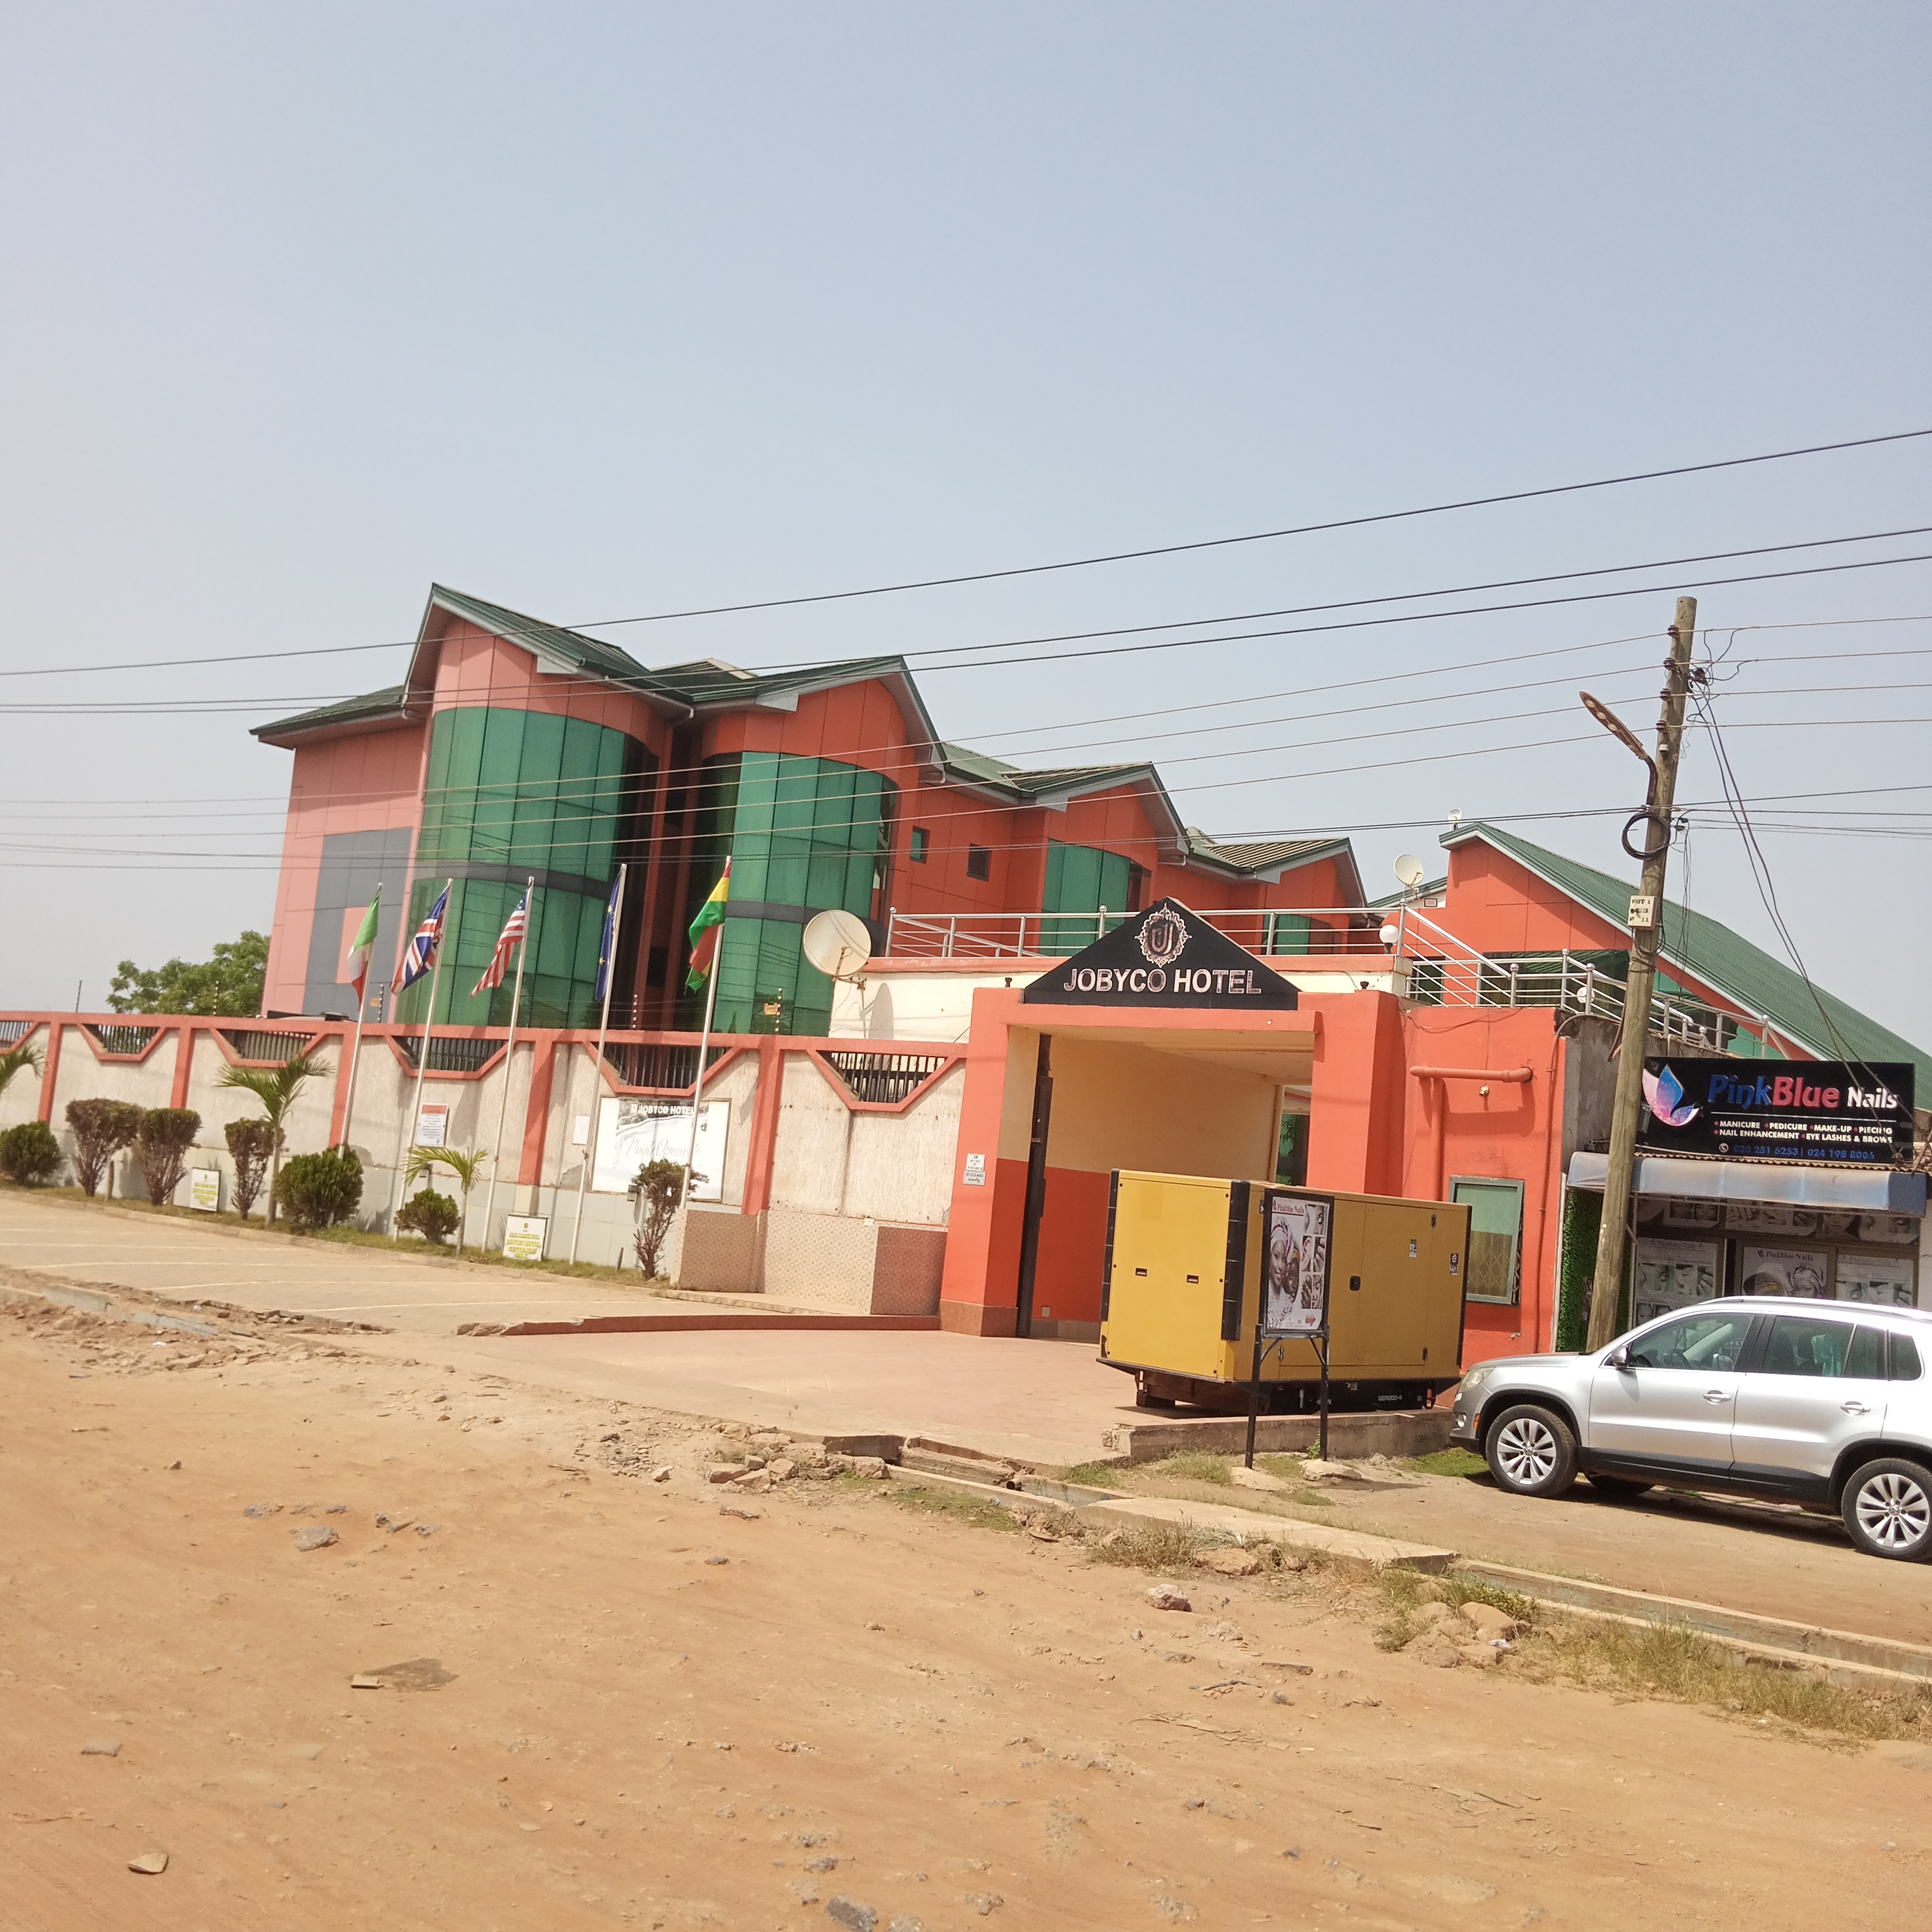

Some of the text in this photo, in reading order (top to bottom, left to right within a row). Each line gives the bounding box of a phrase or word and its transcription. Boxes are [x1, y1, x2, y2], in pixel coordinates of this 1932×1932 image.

[1063, 968, 1262, 994] JOBYCO HOTEL
[1846, 1086, 1899, 1109] Nails
[638, 1105, 669, 1114] JOBYCO
[1719, 1120, 1760, 1129] MANICURE
[1813, 1124, 1852, 1133] MAKE-UP
[1740, 1130, 1800, 1139] ENHANCEMENT
[1821, 1134, 1852, 1142] LASHES
[1862, 1135, 1892, 1144] BROWS
[1754, 1146, 1771, 1154] 251
[1774, 1147, 1798, 1156] 6253
[1829, 1149, 1847, 1158] 198
[1850, 1150, 1874, 1159] 8006
[1766, 1251, 1813, 1261] Pinkblue Nails
